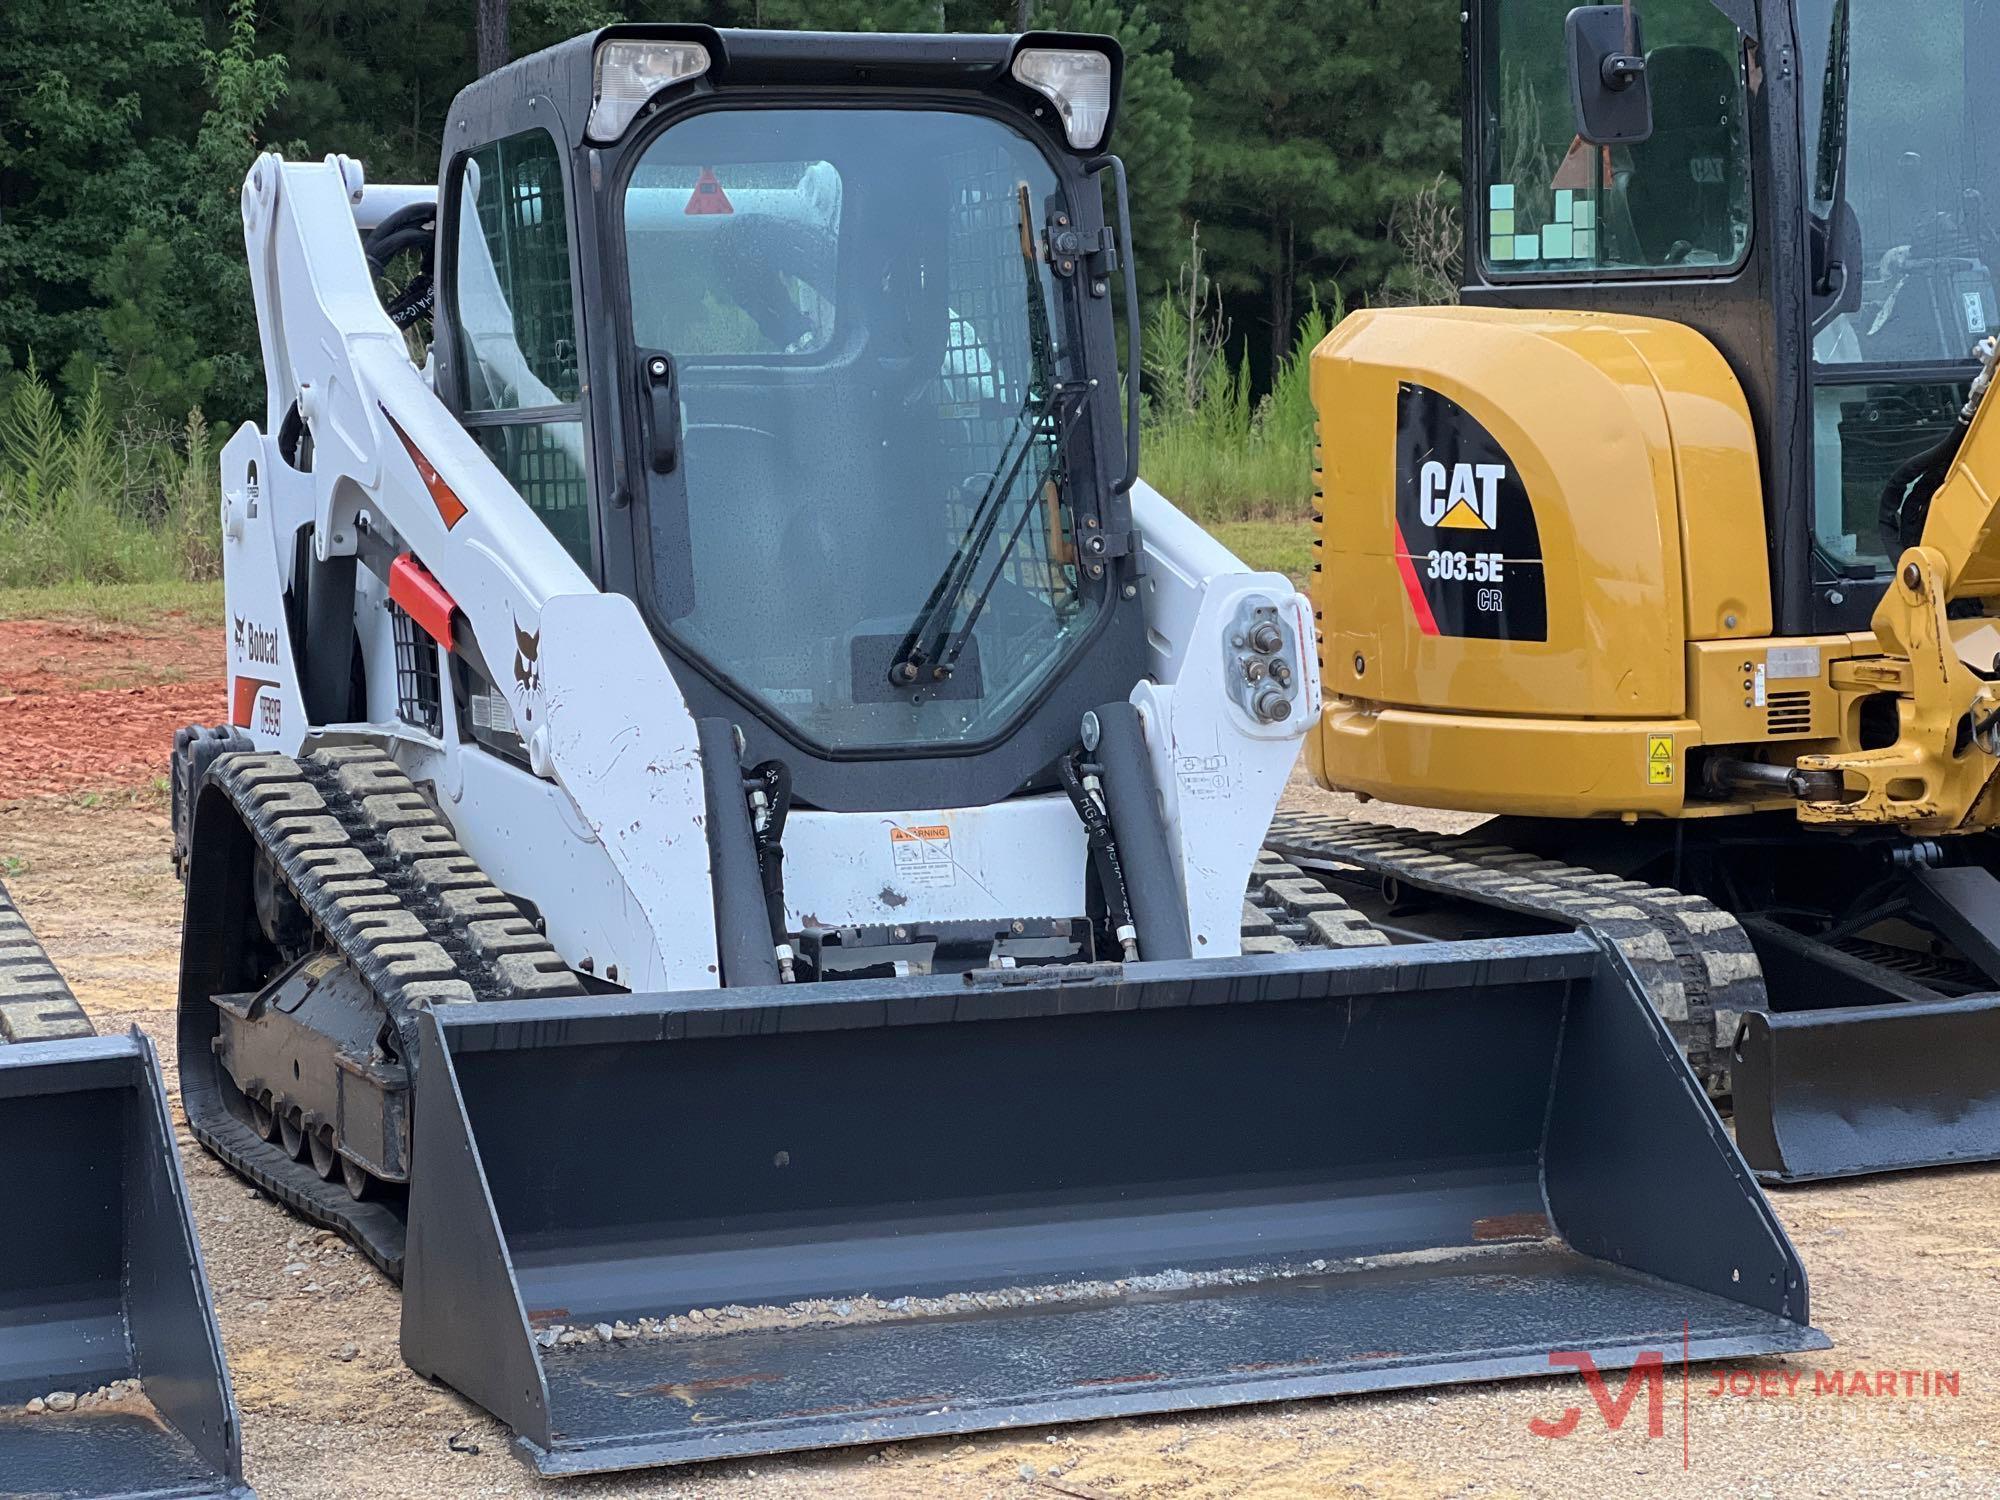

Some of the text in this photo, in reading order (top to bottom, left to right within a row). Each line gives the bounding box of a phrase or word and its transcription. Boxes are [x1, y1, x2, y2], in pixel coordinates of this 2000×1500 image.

[1420, 461, 1506, 530] CAT
[1427, 550, 1504, 582] 303.5E
[1477, 588, 1503, 612] CR
[248, 622, 279, 665] Bobcat
[259, 695, 281, 736] T595
[904, 828, 946, 839] WARNING
